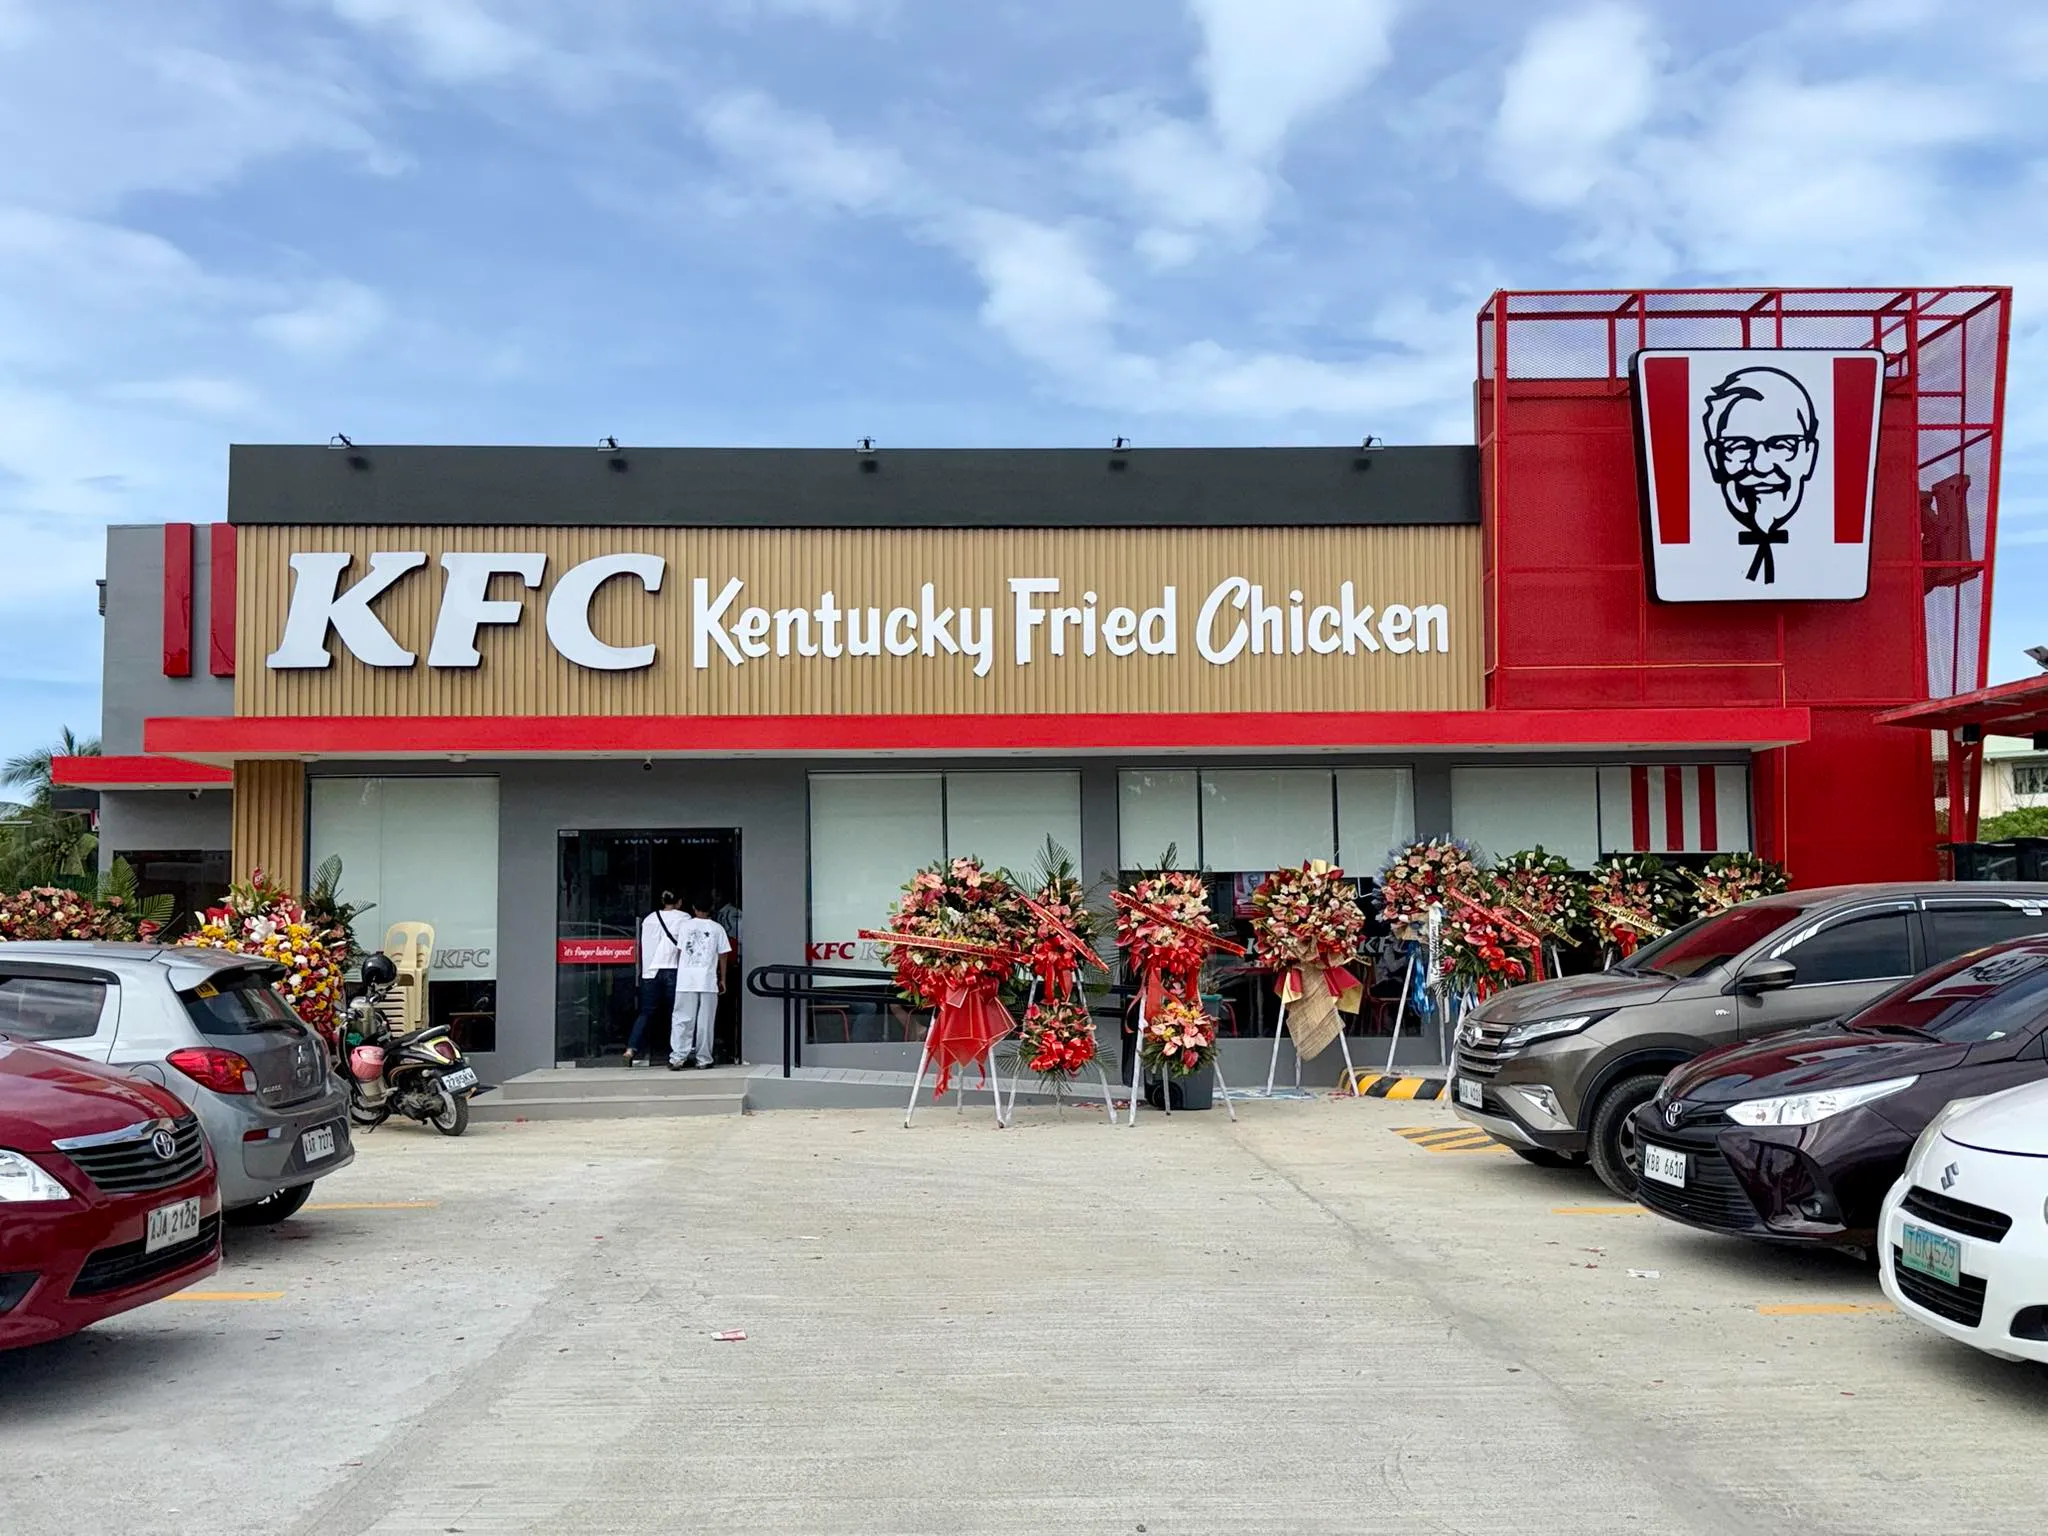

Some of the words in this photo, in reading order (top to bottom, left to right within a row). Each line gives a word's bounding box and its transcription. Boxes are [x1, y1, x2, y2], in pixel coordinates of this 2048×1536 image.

[266, 550, 667, 670] KFC
[692, 577, 994, 678] Kentucky
[1007, 577, 1177, 666] Fried
[1195, 575, 1449, 666] Chicken
[434, 948, 490, 968] KFC
[575, 946, 595, 959] finger
[805, 942, 856, 960] KFC
[1664, 1158, 1684, 1180] 6610
[172, 1204, 198, 1233] 2126
